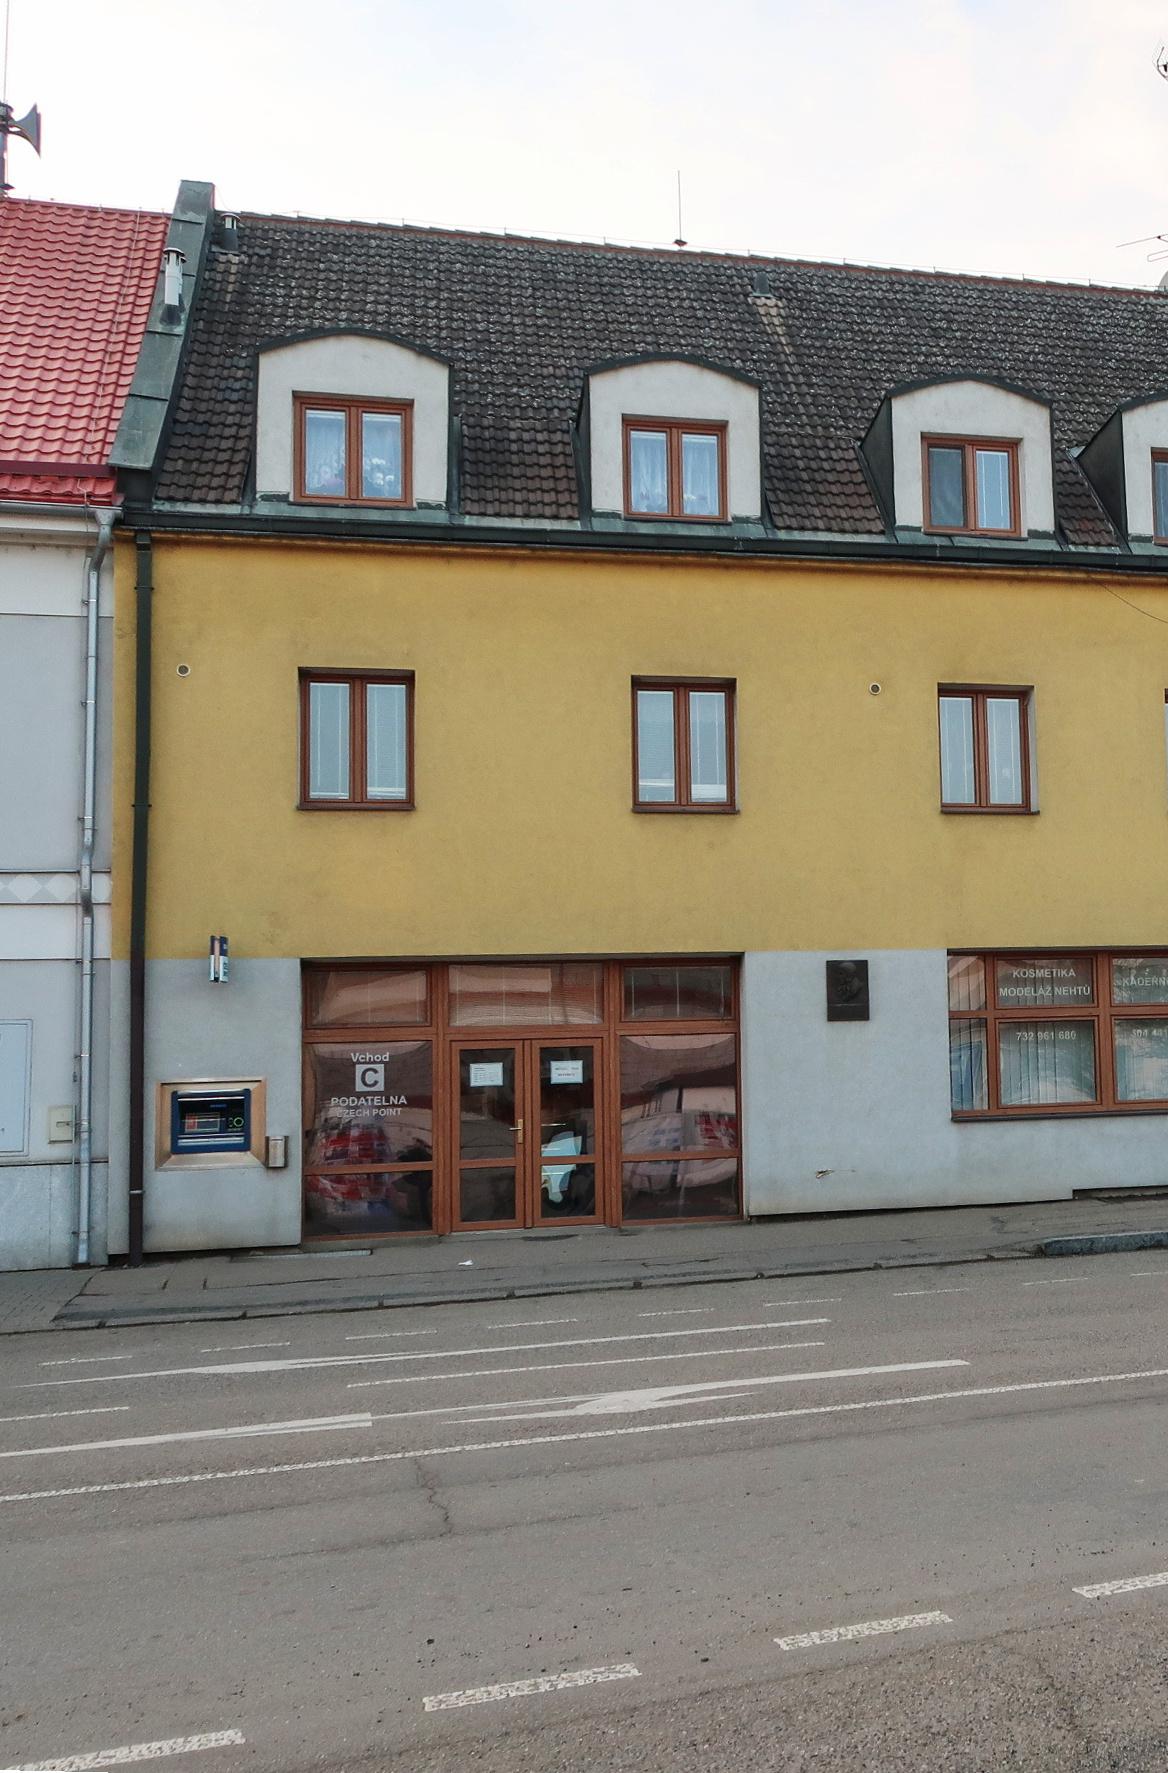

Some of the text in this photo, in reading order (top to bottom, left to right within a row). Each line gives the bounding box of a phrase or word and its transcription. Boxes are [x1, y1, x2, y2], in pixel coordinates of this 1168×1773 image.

[1012, 968, 1076, 978] KOSMETIKA
[1054, 984, 1090, 996] NEHTŮ
[1016, 1032, 1034, 1041] 732
[351, 1052, 390, 1062] Vchod
[360, 1067, 379, 1088] C
[331, 1095, 407, 1106] PODATELNA
[336, 1108, 402, 1118] CZECH POINT
